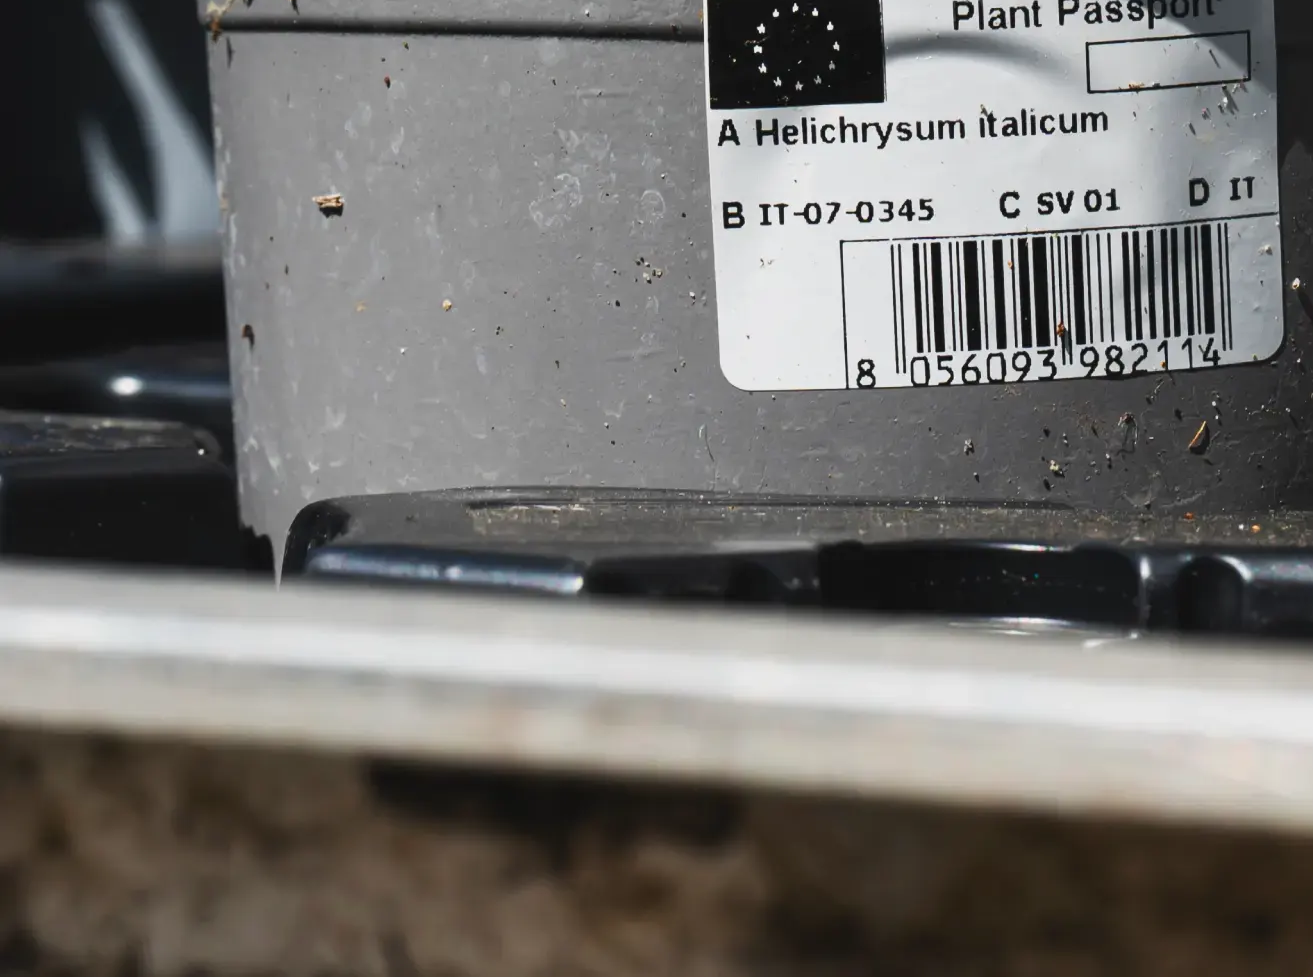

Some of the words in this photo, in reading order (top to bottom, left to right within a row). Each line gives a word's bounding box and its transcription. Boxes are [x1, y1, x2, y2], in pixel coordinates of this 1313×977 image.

[952, 0, 1042, 30] Plant
[718, 118, 740, 146] A
[755, 116, 966, 149] Helichrysum
[979, 108, 1109, 138] italicum
[722, 201, 745, 229] B
[758, 198, 935, 226] IT-07-0345
[999, 191, 1020, 218] C
[1189, 178, 1210, 207] D
[1230, 176, 1255, 201] IT
[856, 358, 876, 388] 8
[910, 347, 1058, 387] 056093
[1079, 337, 1221, 378] 982114
